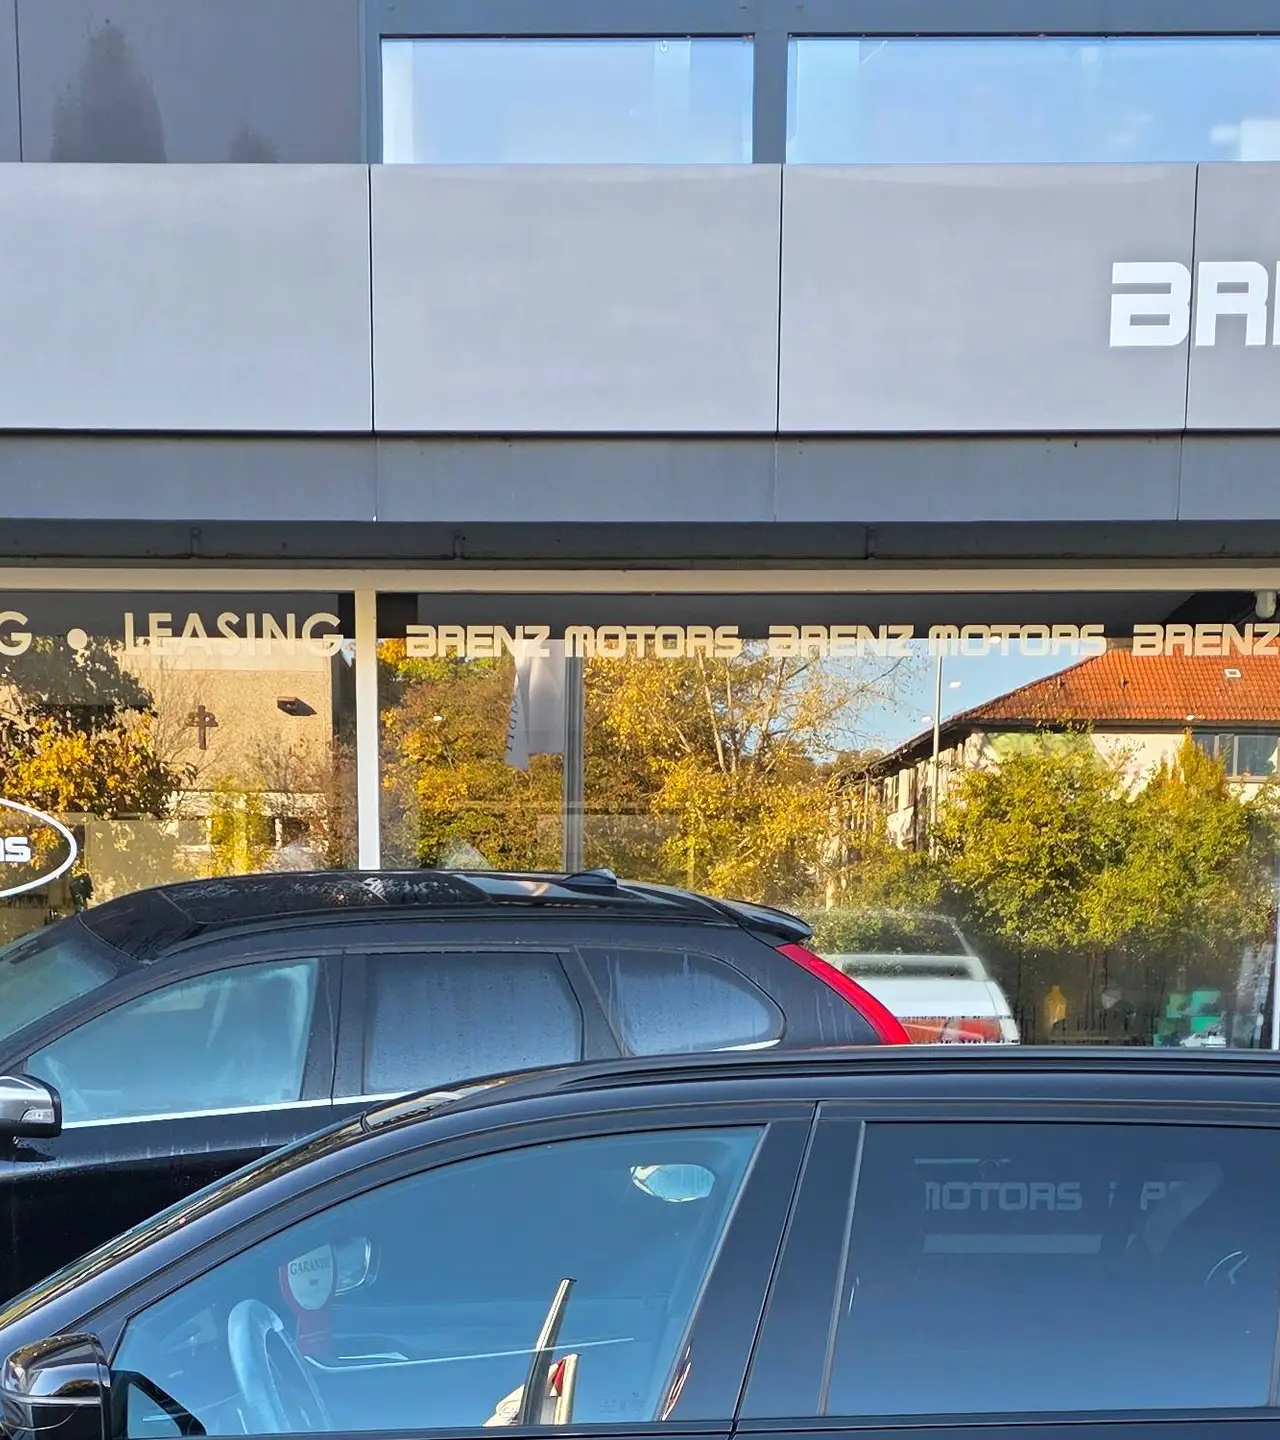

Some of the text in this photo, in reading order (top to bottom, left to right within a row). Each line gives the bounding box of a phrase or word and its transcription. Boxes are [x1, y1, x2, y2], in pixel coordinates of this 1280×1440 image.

[124, 611, 345, 658] LEASING
[406, 623, 1280, 658] BRENZ MOTORS BRENZ MOTORS BRENZ
